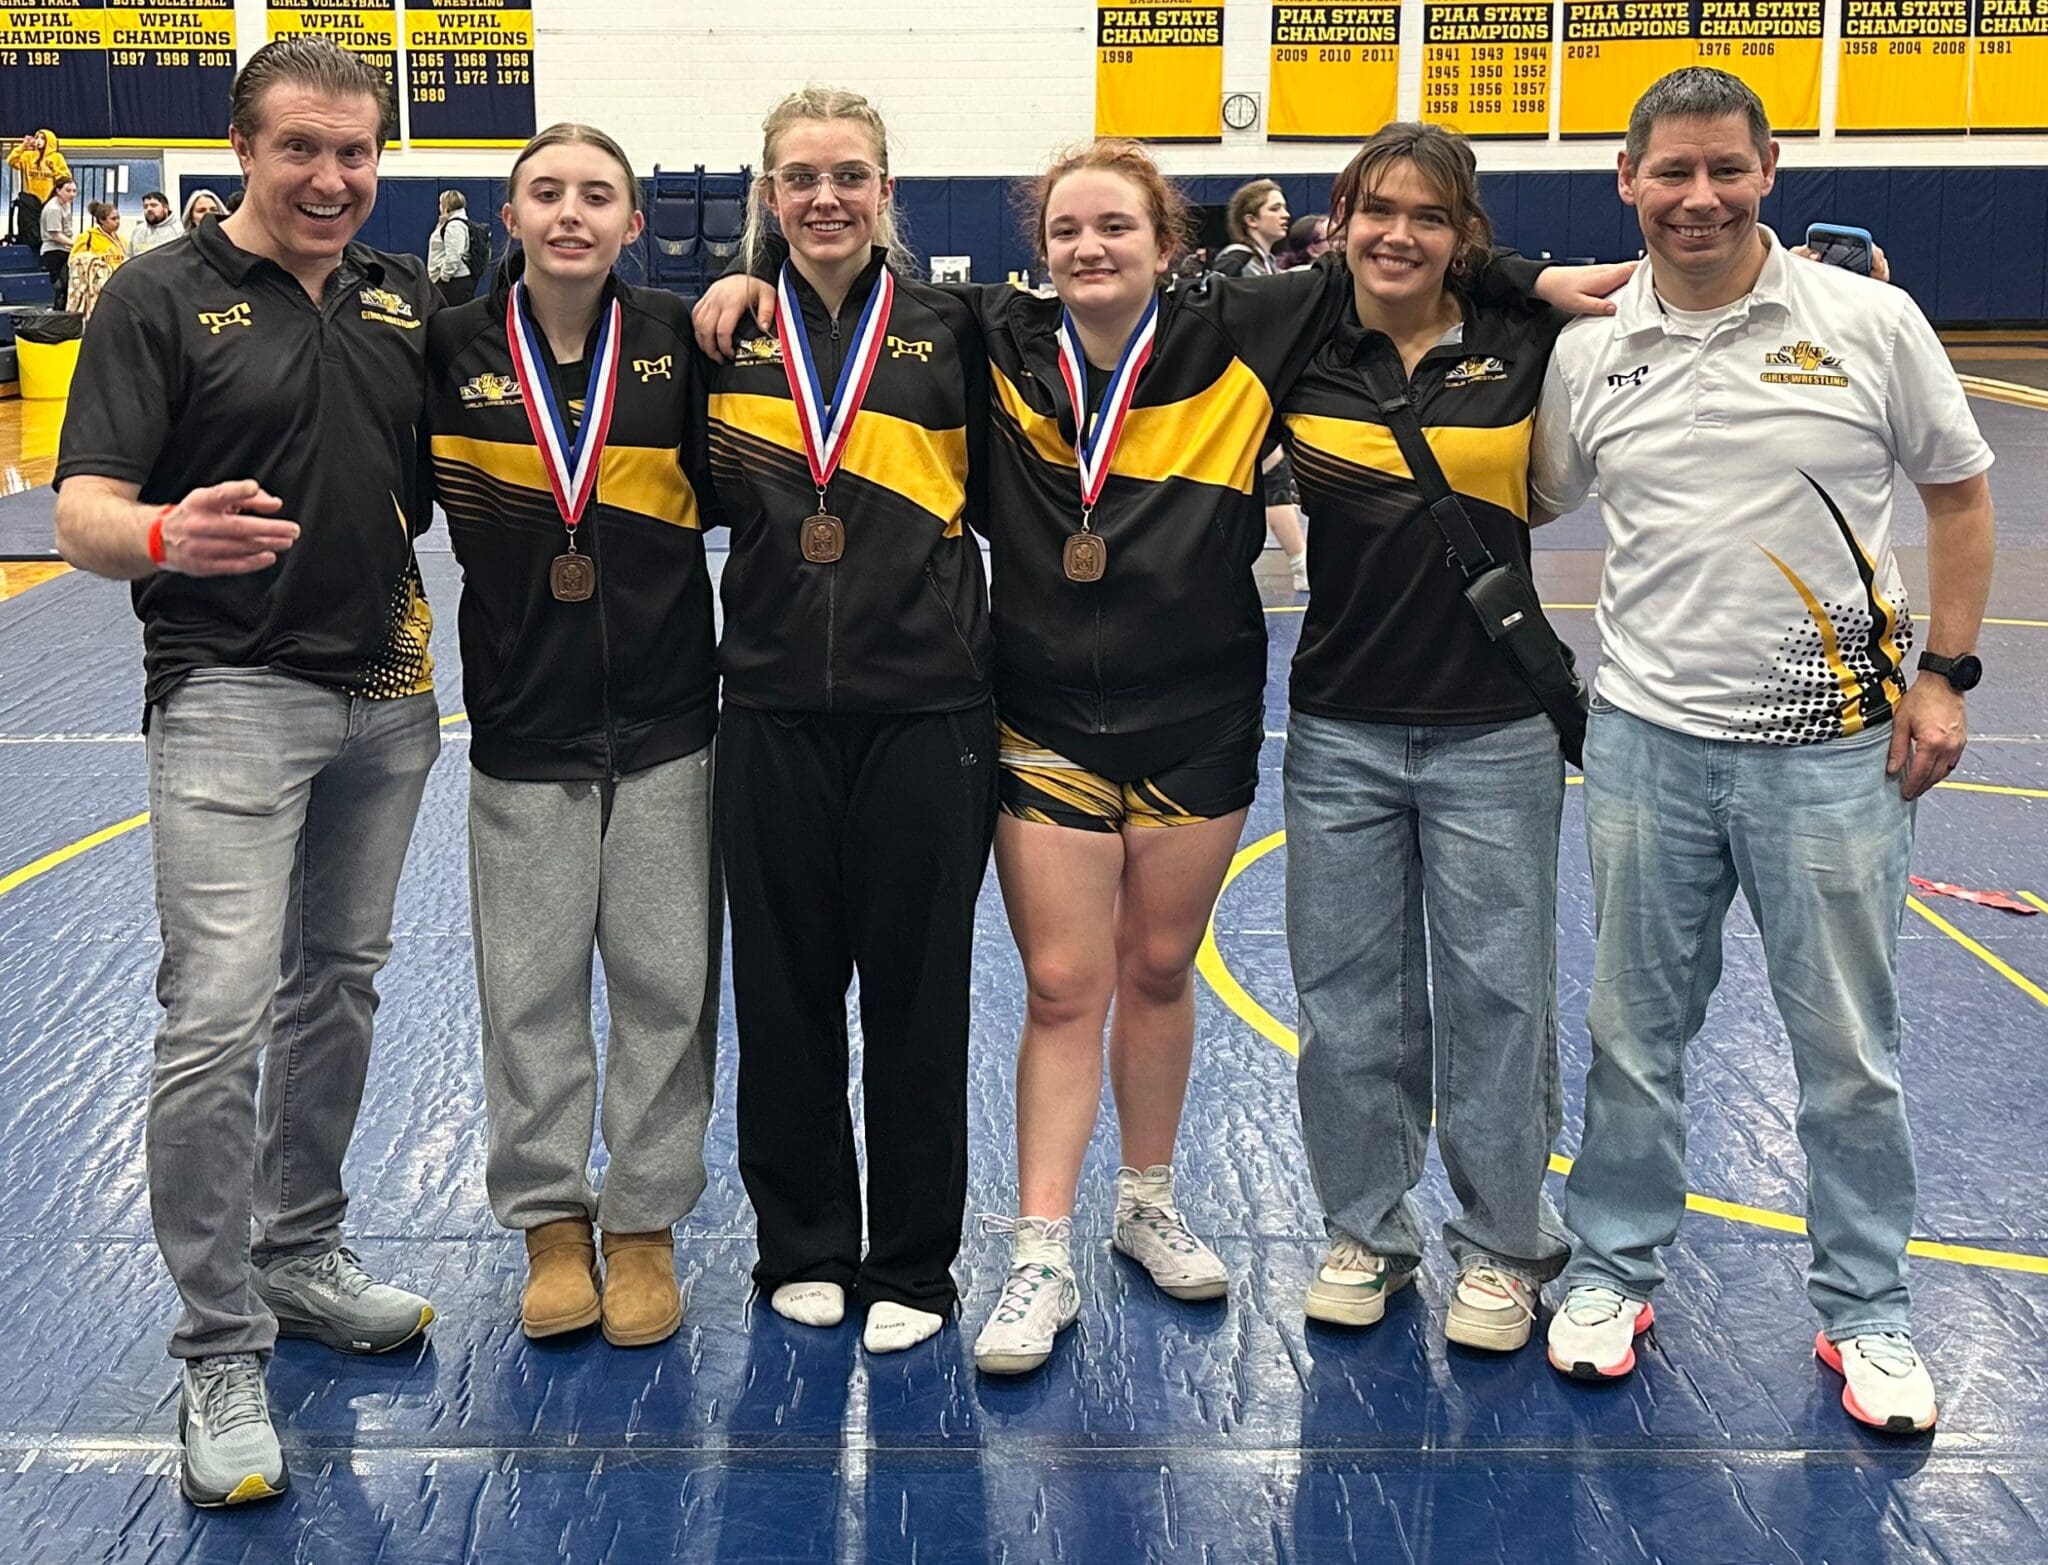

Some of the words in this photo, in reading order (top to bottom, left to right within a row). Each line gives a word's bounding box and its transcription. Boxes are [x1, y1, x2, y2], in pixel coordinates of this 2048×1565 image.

[1431, 7, 1480, 22] PIAA
[1484, 6, 1548, 22] STATE
[1570, 4, 1620, 20] PIAA
[1624, 3, 1689, 19] STATE
[1702, 2, 1751, 18] PIAA
[1755, 2, 1820, 17] STATE
[1848, 1, 1897, 16] PIAA
[1902, 1, 1966, 16] STATE
[1982, 0, 2032, 15] PIAA
[9, 13, 73, 27] WPIAL
[139, 13, 203, 28] WPIAL
[300, 14, 364, 28] WPIAL
[437, 14, 501, 28] WPIAL
[1103, 11, 1151, 26] PIAA
[1155, 10, 1218, 26] STATE
[1279, 9, 1327, 24] PIAA
[1331, 9, 1395, 24] STATE
[1277, 26, 1396, 42] CHAMPIONS
[1429, 24, 1549, 40] CHAMPIONS
[1568, 20, 1690, 38] CHAMPIONS
[1700, 20, 1821, 35] CHAMPIONS
[1846, 19, 1967, 34] CHAMPIONS
[113, 30, 231, 45] CHAMPIONS
[412, 31, 528, 45] CHAMPIONS
[1102, 28, 1219, 43] CHAMPIONS
[1428, 48, 1460, 61] 1941
[1471, 47, 1504, 61] 1943
[1514, 47, 1547, 60] 1944
[1568, 45, 1600, 59] 2021
[1698, 42, 1731, 56] 1976
[1742, 42, 1775, 56] 2006
[1846, 41, 1878, 55] 1958
[1889, 41, 1921, 55] 2004
[1933, 41, 1966, 54] 2008
[1979, 41, 2012, 54] 1981
[27, 51, 60, 66] 1982
[112, 51, 146, 66] 1997
[156, 52, 190, 67] 1998
[199, 52, 232, 67] 2001
[411, 53, 444, 67] 1965
[454, 53, 487, 67] 1968
[496, 53, 529, 67] 1969
[1102, 50, 1133, 63] 1998
[1276, 49, 1308, 62] 2009
[1319, 49, 1351, 62] 2010
[1362, 49, 1394, 62] 2011
[412, 71, 446, 85] 1971
[454, 71, 488, 85] 1972
[497, 71, 530, 85] 1978
[1427, 66, 1460, 79] 1945
[1470, 65, 1503, 78] 1950
[1513, 65, 1546, 78] 1952
[413, 88, 446, 102] 1980
[1427, 83, 1459, 96] 1953
[1470, 82, 1502, 96] 1956
[1513, 82, 1545, 95] 1957
[1426, 100, 1458, 114] 1958
[1469, 100, 1501, 113] 1959
[1513, 99, 1545, 113] 1998
[1760, 372, 1789, 383] GIRLS
[1790, 374, 1849, 388] WRESTLING
[308, 1281, 341, 1303] BROOKS
